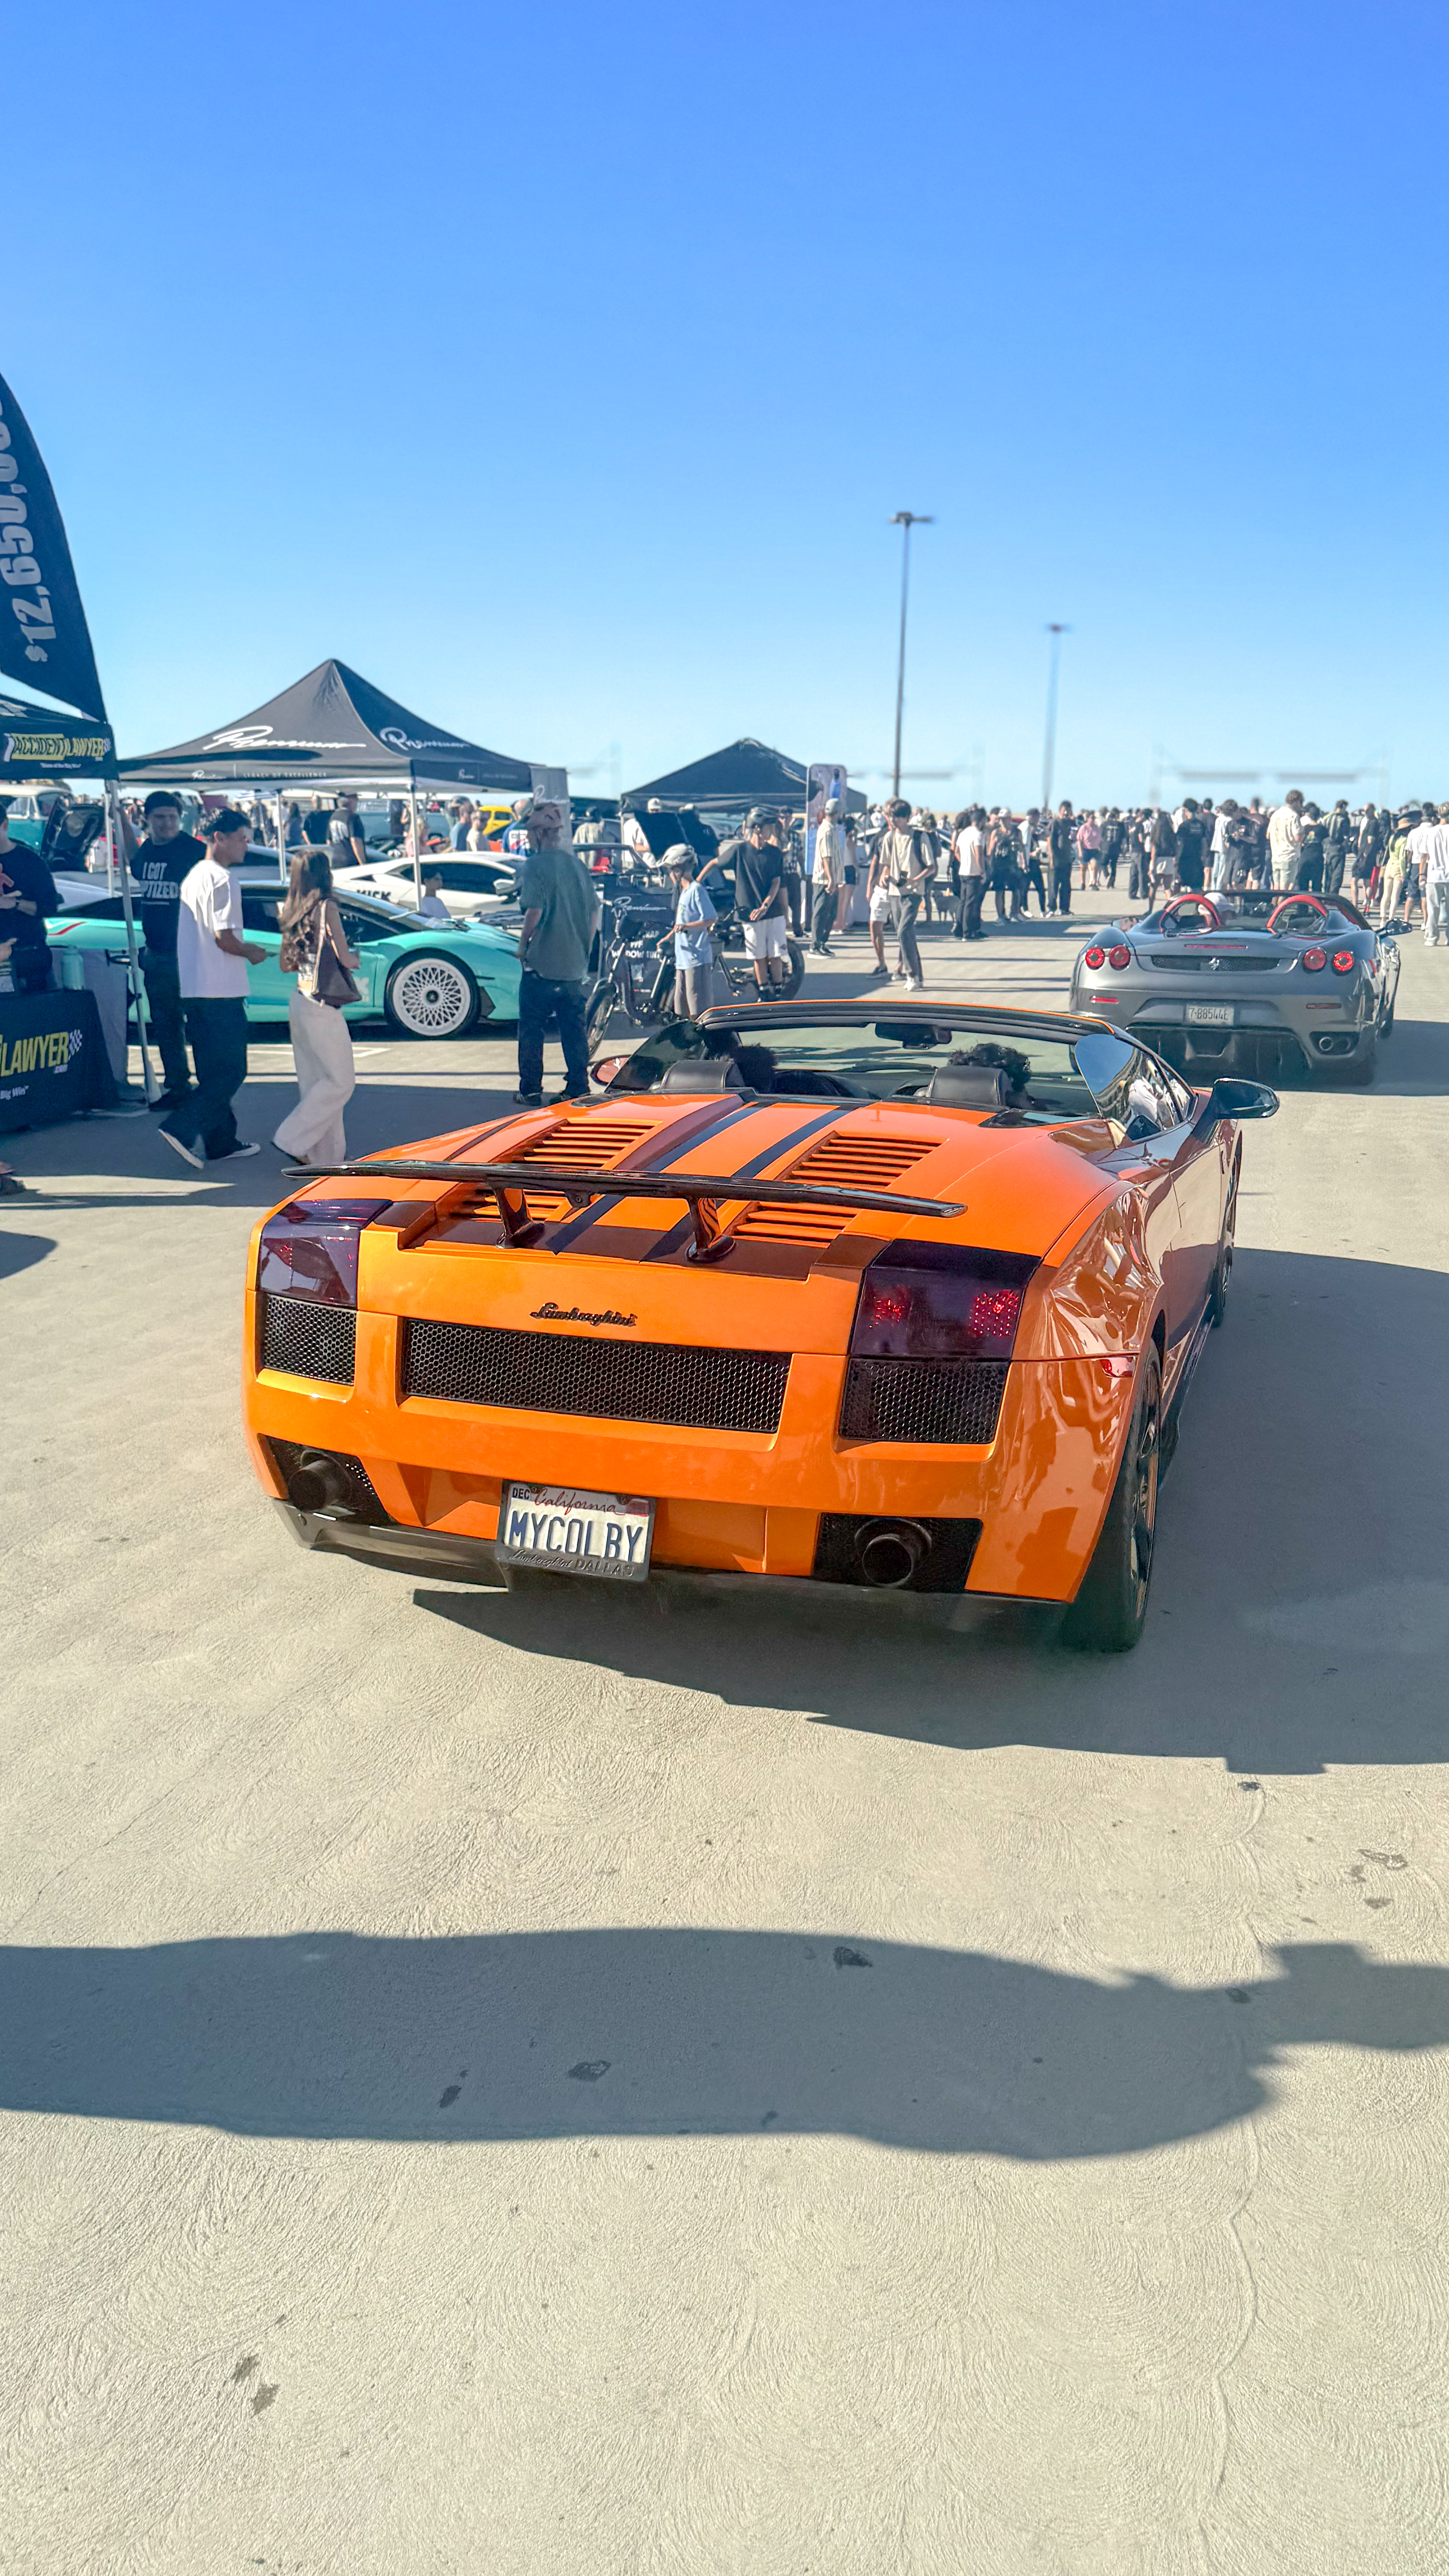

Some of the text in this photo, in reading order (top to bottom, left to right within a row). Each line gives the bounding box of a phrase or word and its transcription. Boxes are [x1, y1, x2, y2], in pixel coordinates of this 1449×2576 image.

[0, 399, 56, 662] $12,650,
[147, 862, 167, 880] GOT
[530, 1302, 637, 1327] Lamborghini
[513, 1488, 530, 1499] DEC
[535, 1488, 626, 1515] California
[509, 1510, 644, 1563] MYCOLBY
